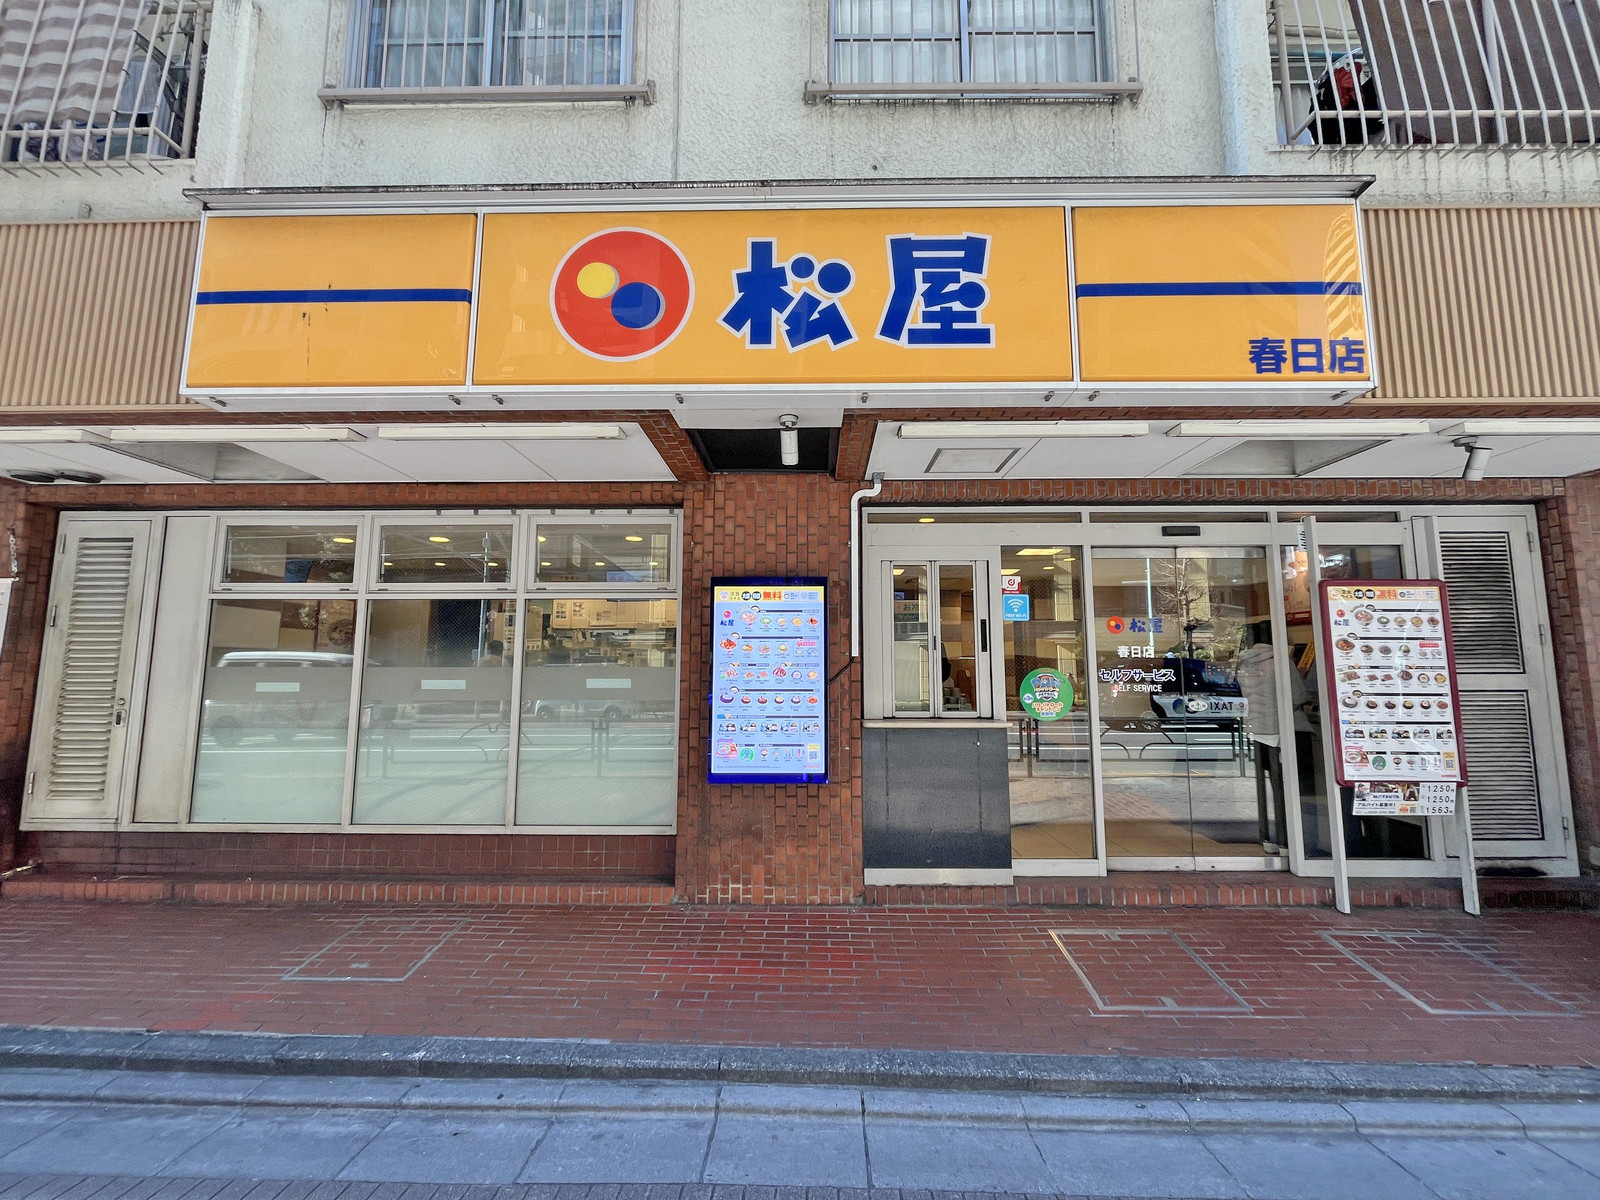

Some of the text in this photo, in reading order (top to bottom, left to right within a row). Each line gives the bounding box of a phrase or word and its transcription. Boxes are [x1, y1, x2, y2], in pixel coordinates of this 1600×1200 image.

[716, 231, 996, 353] 松屋
[1249, 337, 1365, 374] 春日店
[1129, 618, 1163, 633] 松屋
[1117, 645, 1155, 658] 春日店
[1099, 669, 1176, 682] セルフサービス
[1115, 684, 1162, 692] SELF SERVICE
